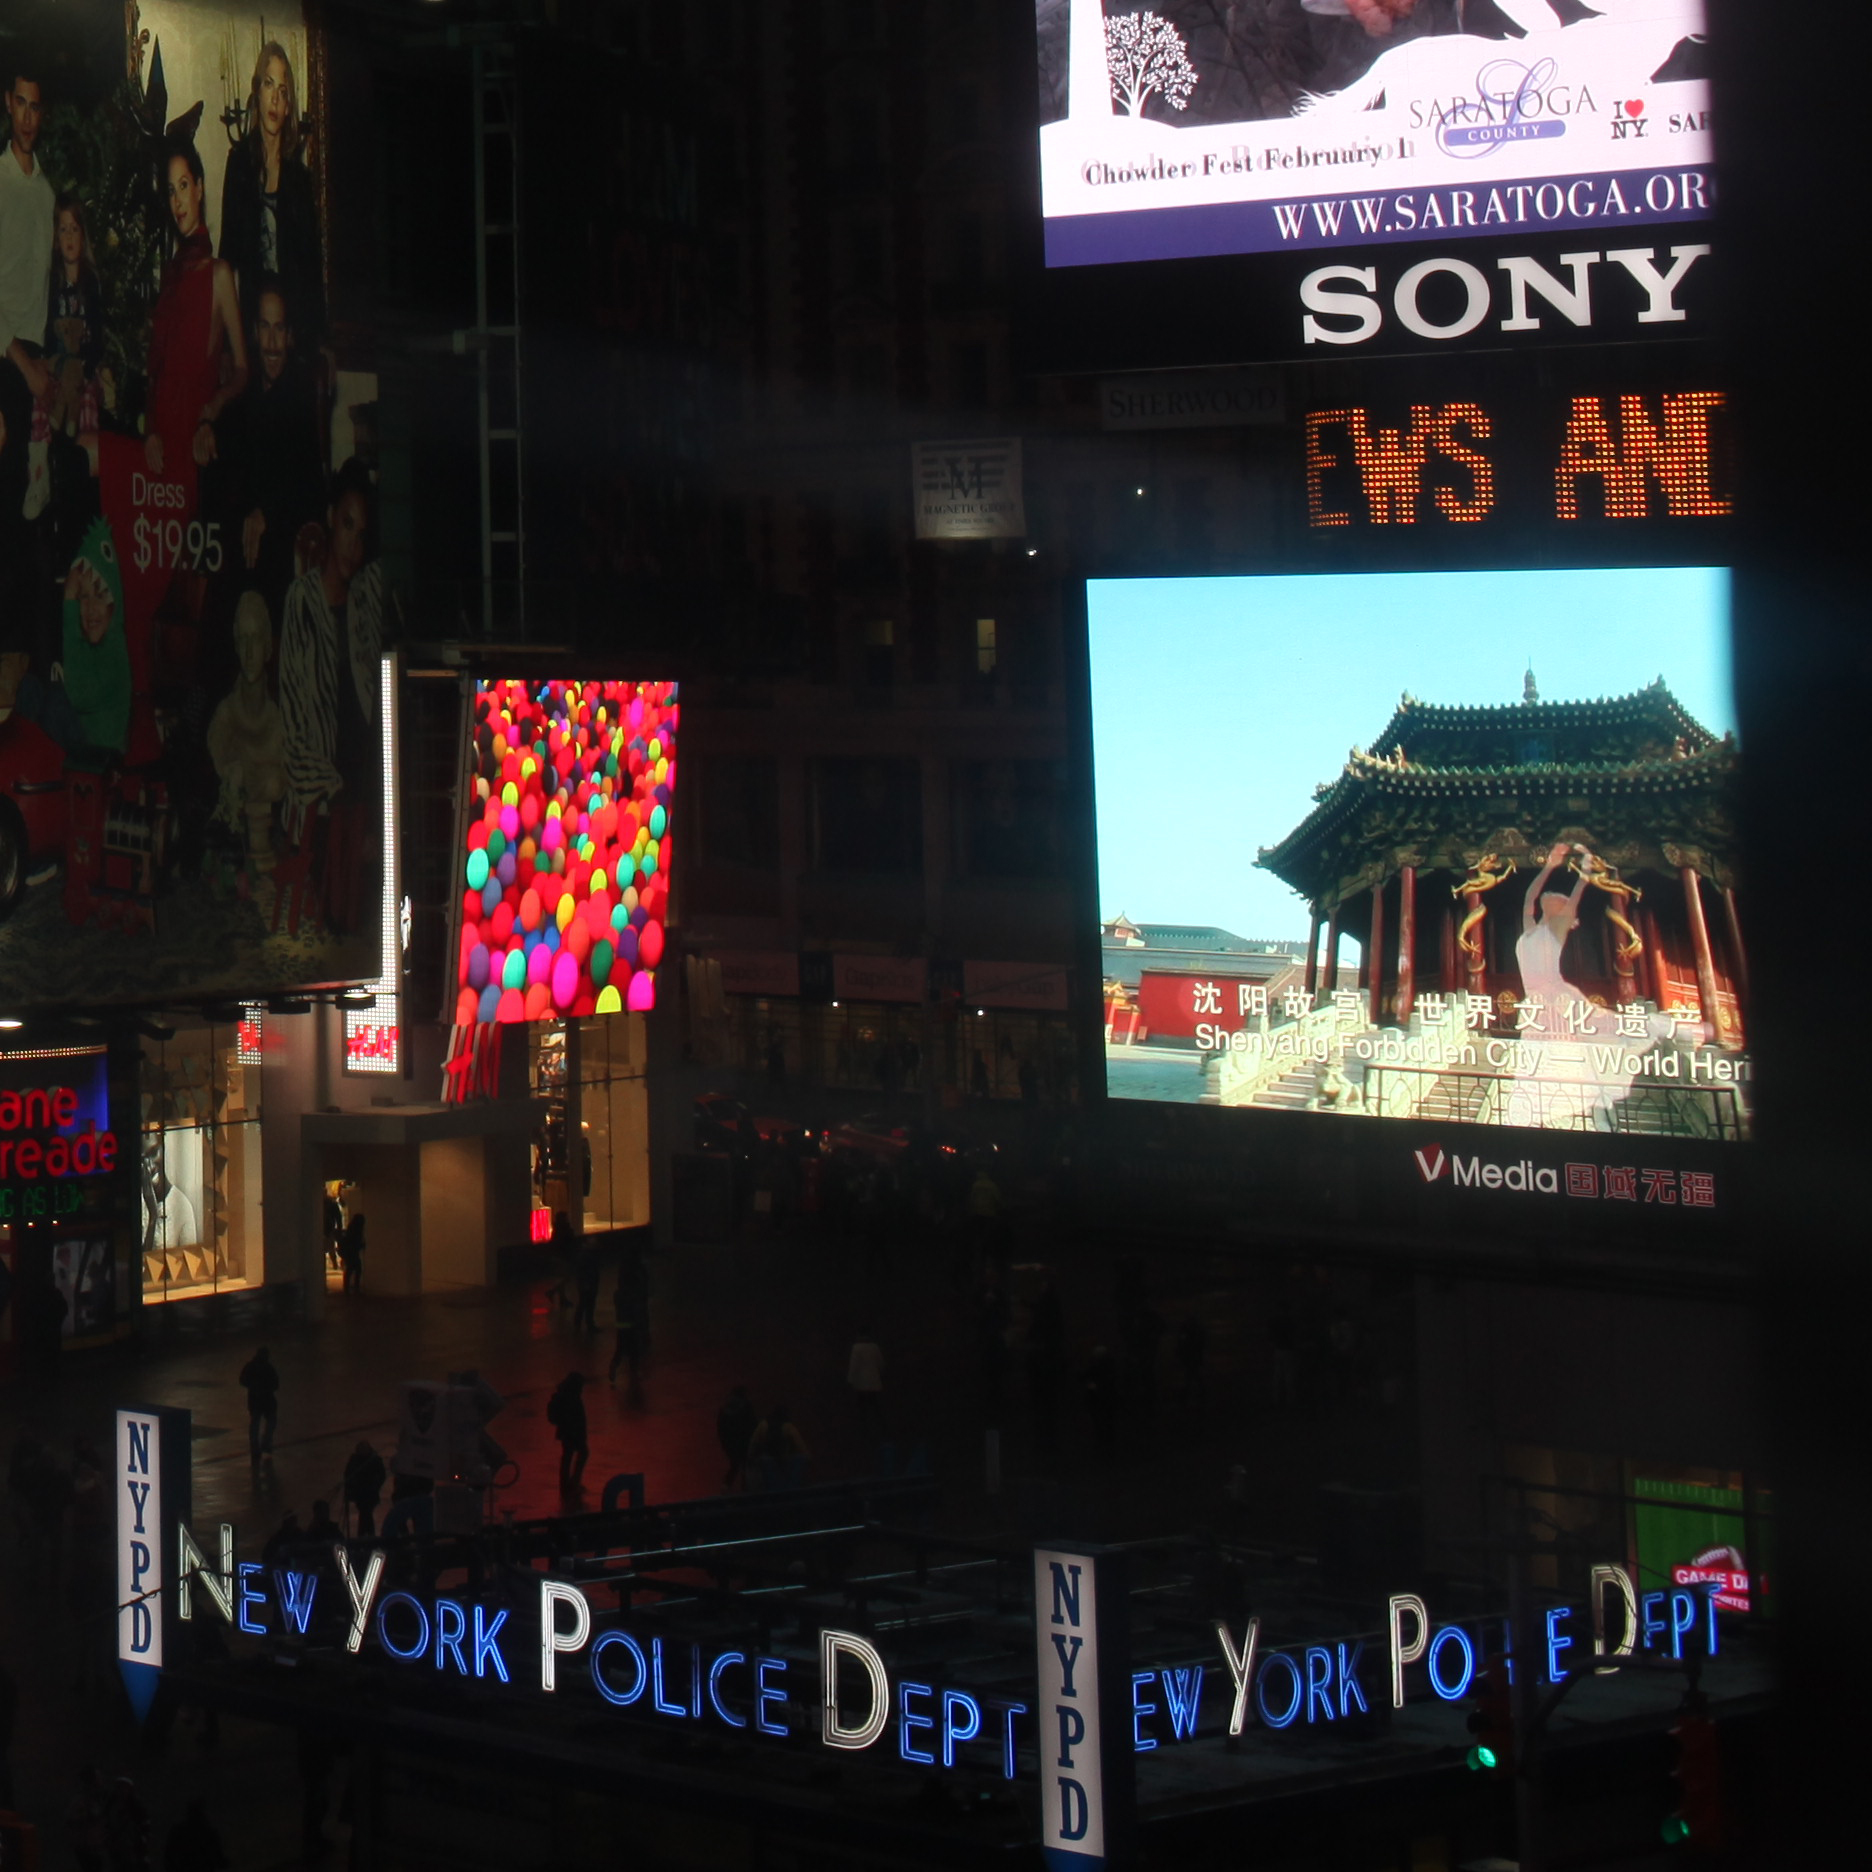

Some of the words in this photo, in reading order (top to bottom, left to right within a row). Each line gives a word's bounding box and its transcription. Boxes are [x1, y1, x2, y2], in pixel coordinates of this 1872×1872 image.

[1409, 84, 1598, 130] SARATOGA
[1467, 123, 1540, 141] COUNTY
[1611, 118, 1648, 140] NY
[1085, 159, 1192, 187] Chowder
[1203, 152, 1253, 176] Fest
[1265, 141, 1384, 171] February
[1272, 173, 1711, 240] WWW.SARATOGA.OR
[1300, 244, 1710, 345] SONY
[1110, 388, 1277, 418] SHERWOOD
[132, 471, 186, 509] Dress
[1305, 402, 1496, 527] EWS
[132, 512, 223, 574] $19.95
[1193, 982, 1363, 1025] 沈阳故宫
[1414, 992, 1702, 1040] 世界文化遗产
[1196, 1023, 1331, 1063] Shenyang
[1338, 1033, 1476, 1066] Forbidden
[1487, 1039, 1542, 1076] City
[1593, 1046, 1680, 1080] World
[0, 1118, 119, 1179] reade
[1452, 1154, 1559, 1195] Media
[22, 1186, 46, 1214] AS
[126, 1420, 152, 1655] NYPD
[1049, 1562, 1089, 1842] NYPD
[1131, 1667, 1202, 1751] EW
